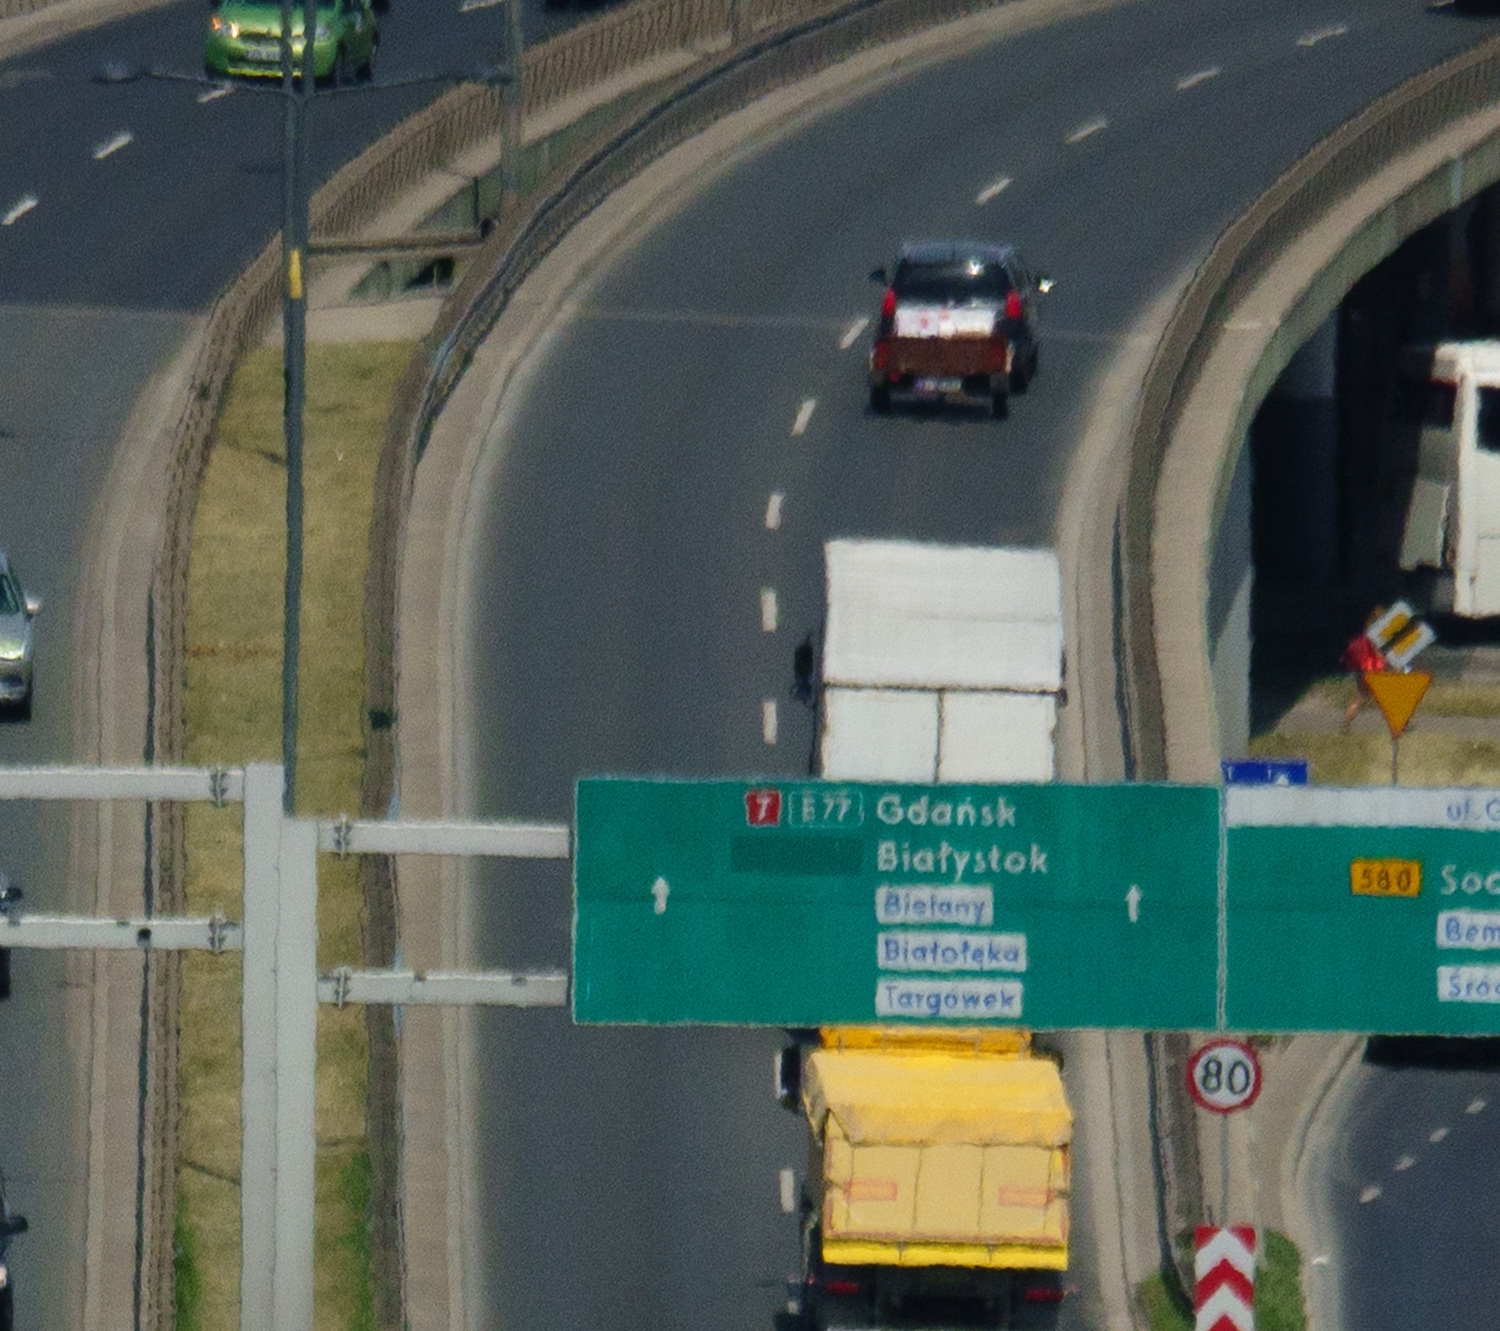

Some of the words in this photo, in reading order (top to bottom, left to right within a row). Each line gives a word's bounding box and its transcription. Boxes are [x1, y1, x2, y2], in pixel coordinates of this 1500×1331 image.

[756, 795, 771, 822] 7
[877, 795, 1016, 827] Gdańsk
[877, 841, 1048, 883] Białystok
[1359, 868, 1412, 894] 580
[883, 891, 986, 924] Bielany
[883, 937, 1019, 972] Białołęka
[884, 984, 1016, 1016] Targówek
[1202, 1059, 1250, 1095] 80
